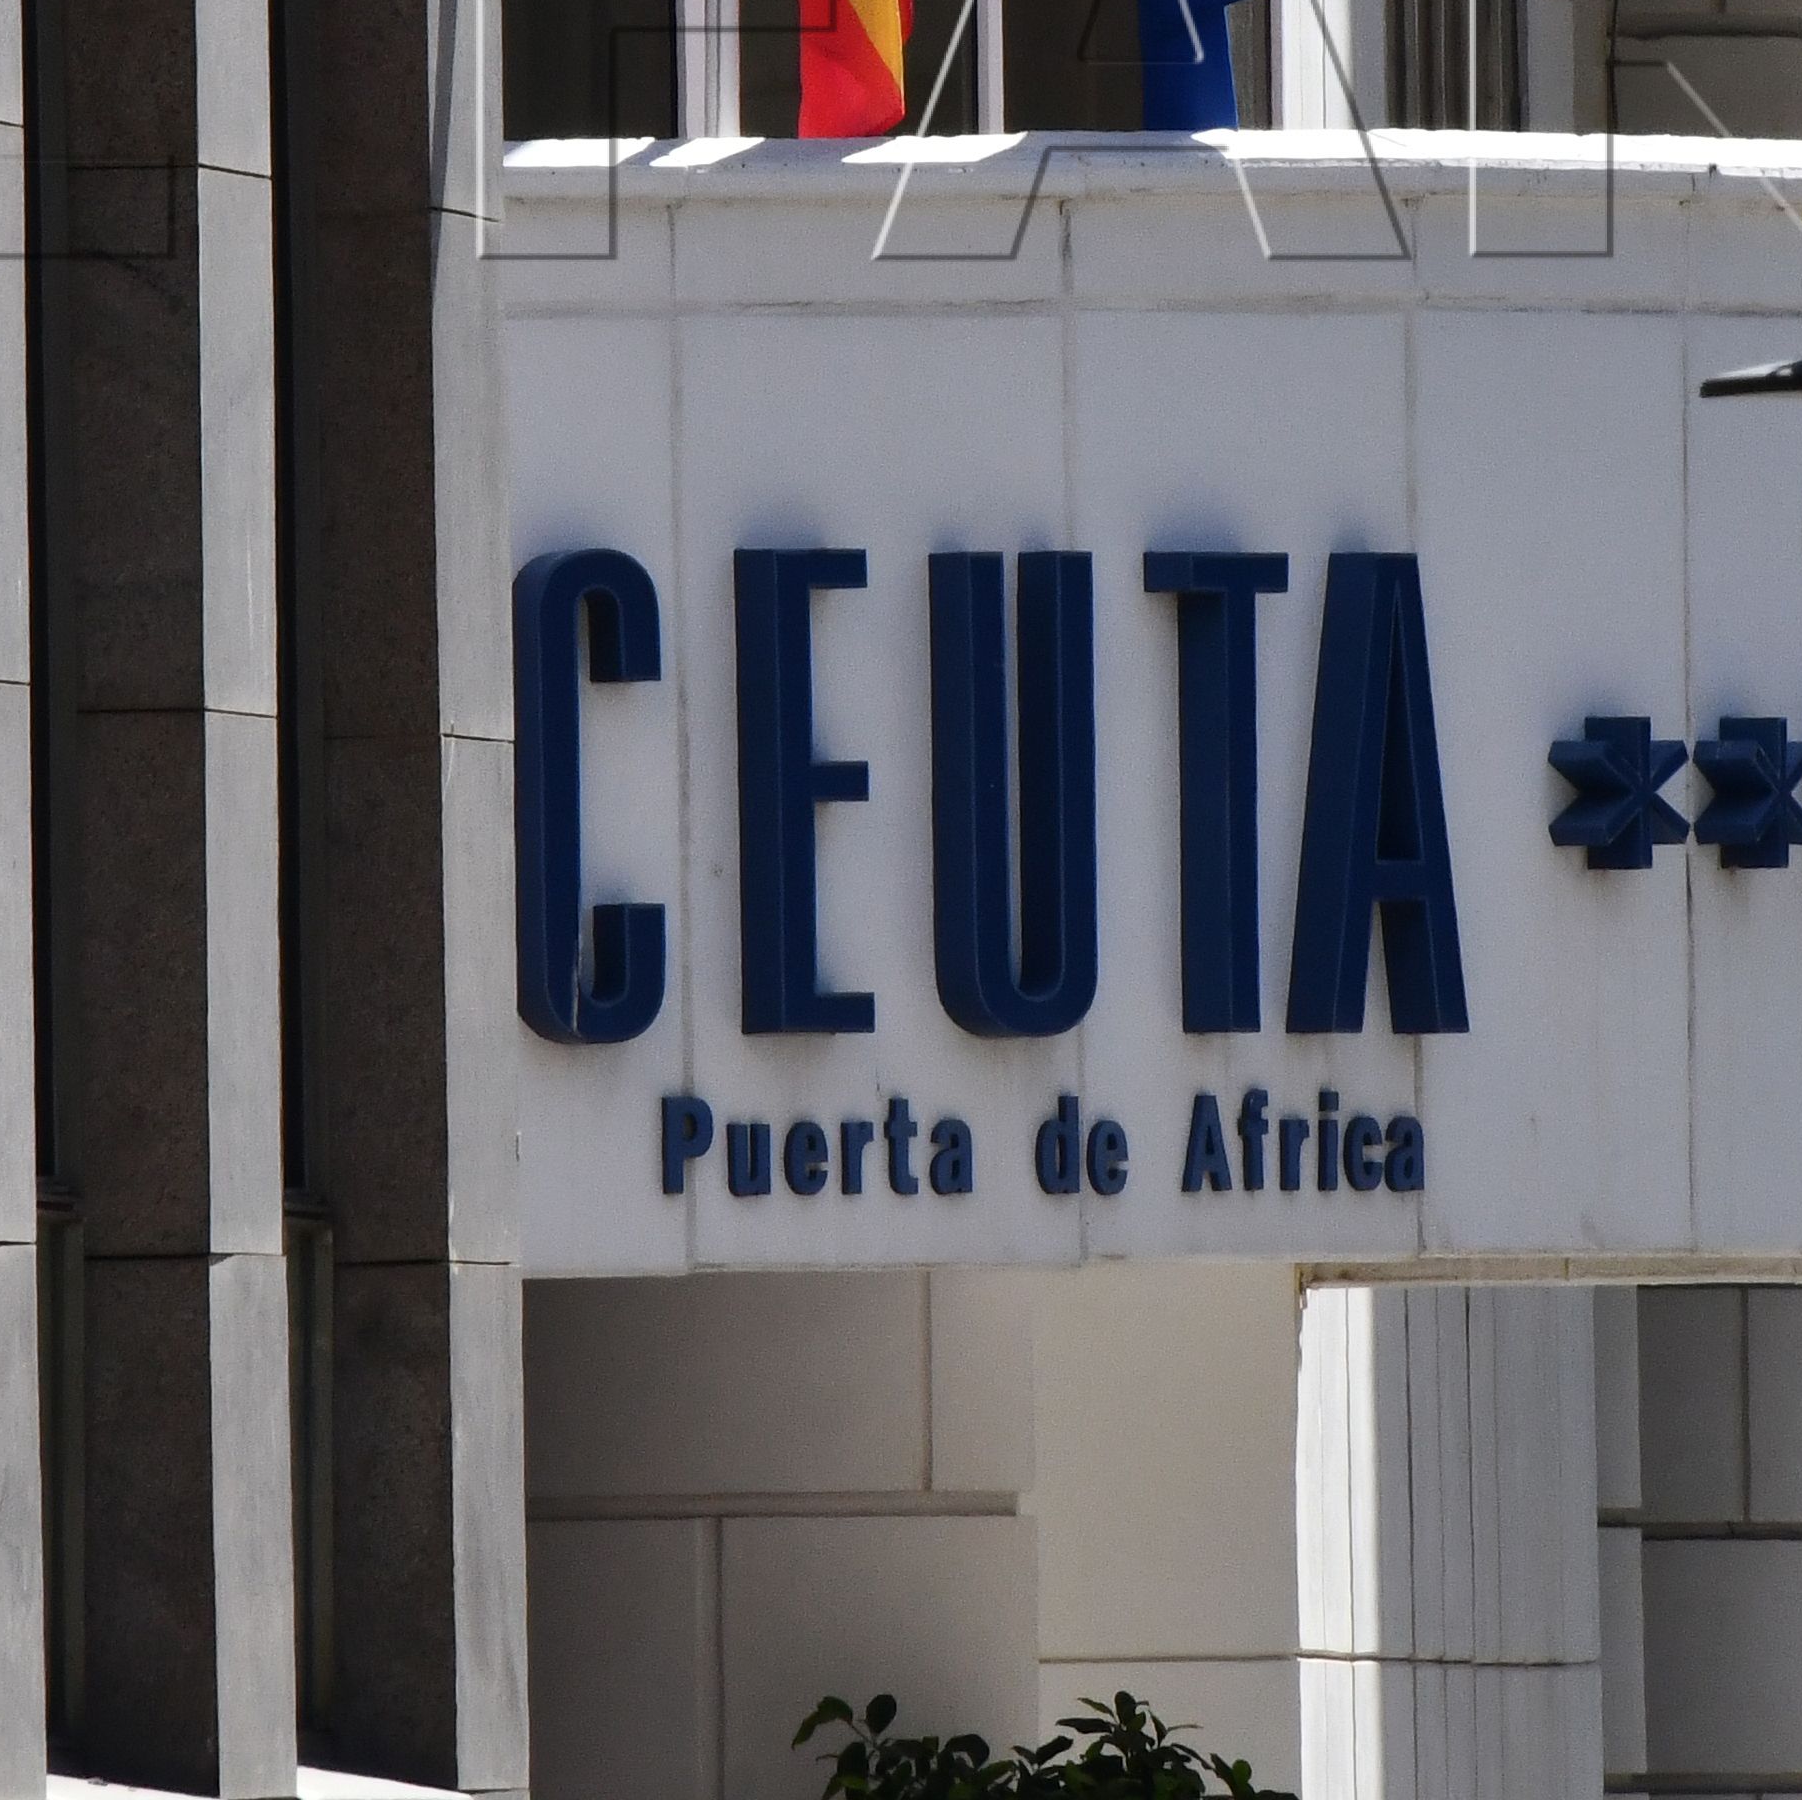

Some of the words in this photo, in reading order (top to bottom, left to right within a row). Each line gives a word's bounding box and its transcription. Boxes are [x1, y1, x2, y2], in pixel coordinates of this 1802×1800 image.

[515, 546, 1470, 1043] CEUTA
[663, 1093, 973, 1196] Puerta
[1038, 1093, 1130, 1196] de
[1183, 1086, 1427, 1194] Africa
